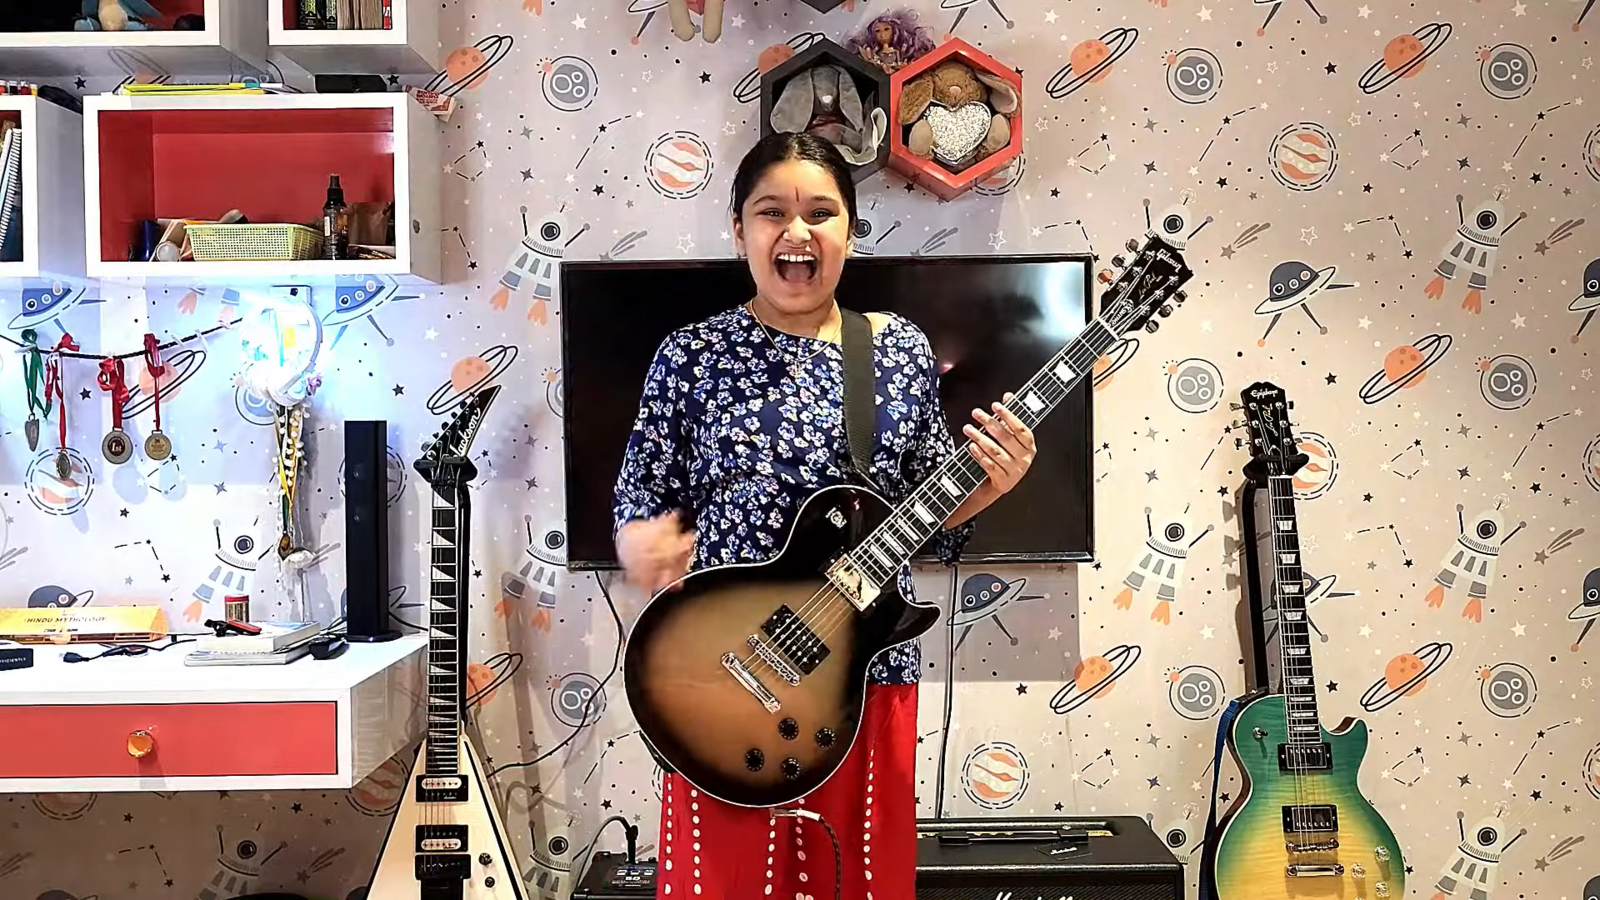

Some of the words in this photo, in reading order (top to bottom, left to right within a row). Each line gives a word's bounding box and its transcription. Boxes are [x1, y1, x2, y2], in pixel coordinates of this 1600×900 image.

[1156, 248, 1182, 273] Gibson
[1250, 388, 1278, 399] Epiphone
[449, 407, 481, 458] Jackson
